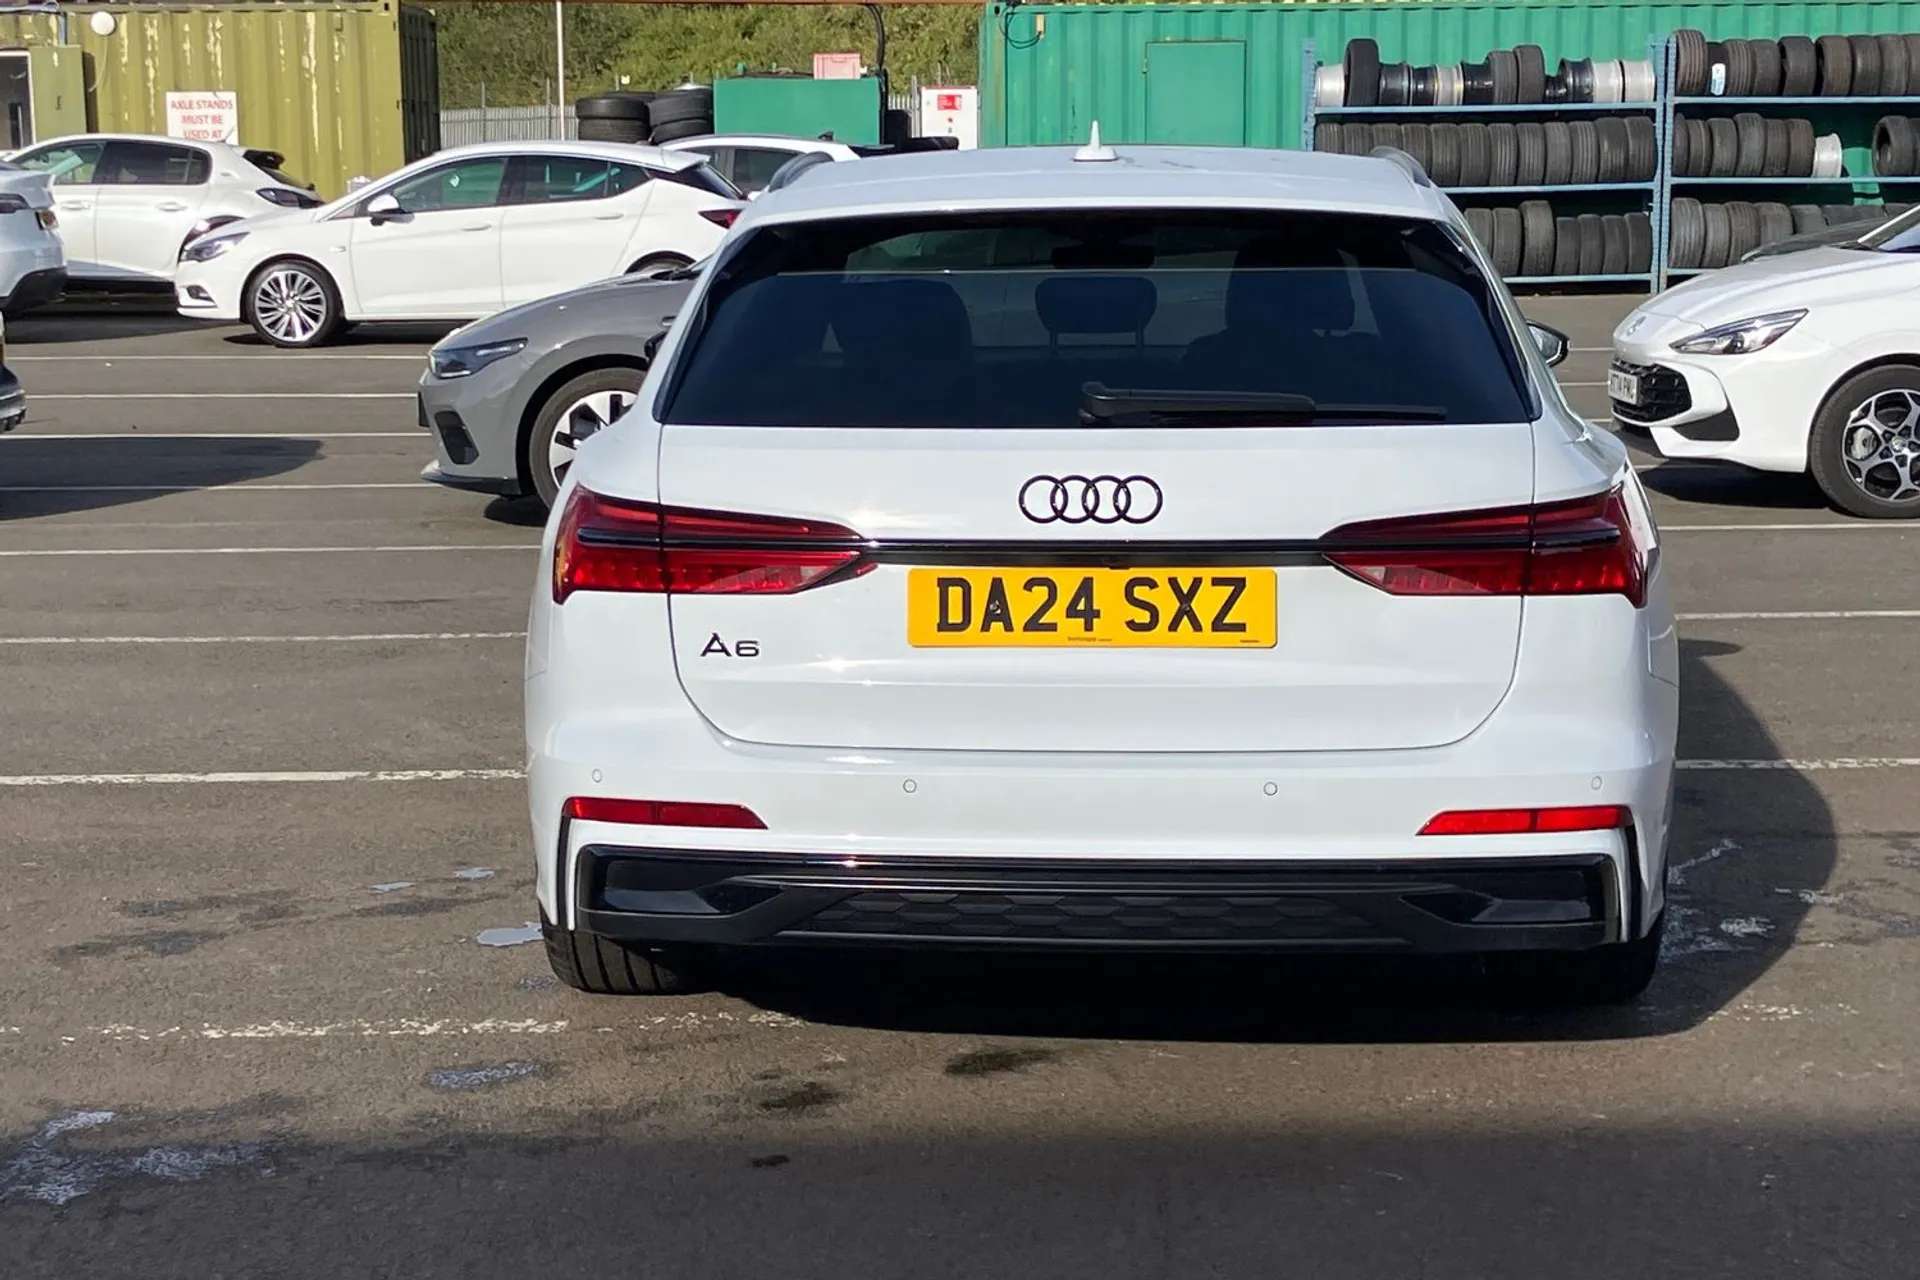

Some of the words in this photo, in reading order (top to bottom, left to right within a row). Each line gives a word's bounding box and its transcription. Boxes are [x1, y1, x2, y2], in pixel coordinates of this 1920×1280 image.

[171, 100, 195, 109] AXLE
[196, 99, 233, 109] STANDS
[181, 115, 209, 124] MUST
[211, 115, 224, 124] BE
[184, 130, 209, 139] USED
[211, 130, 223, 139] AT
[937, 577, 1101, 632] DA24
[1124, 577, 1247, 632] SXZ
[700, 632, 760, 657] A6
